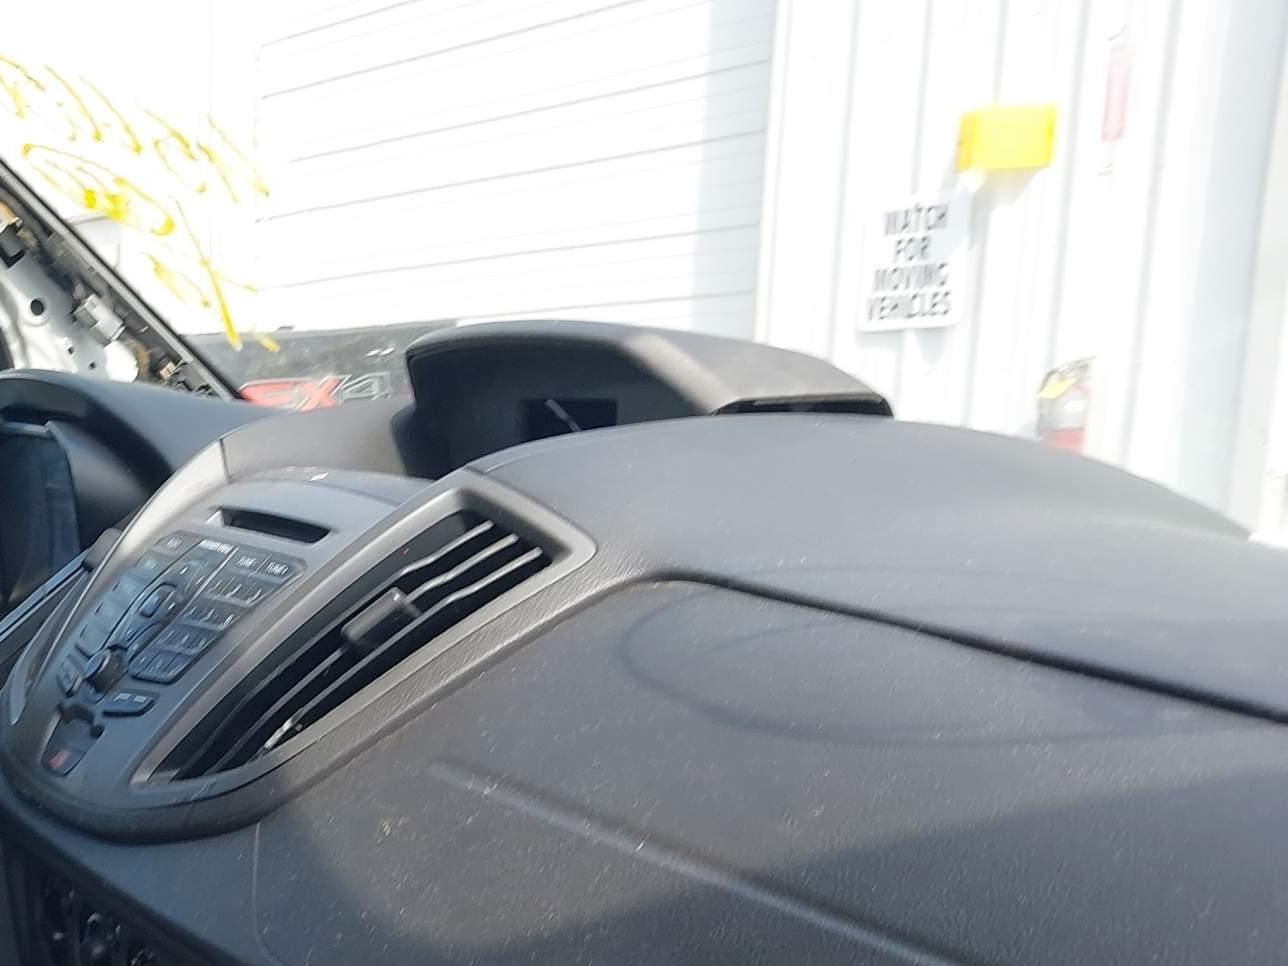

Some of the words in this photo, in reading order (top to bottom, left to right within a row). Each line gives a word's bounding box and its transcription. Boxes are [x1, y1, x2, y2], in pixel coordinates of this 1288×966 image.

[883, 204, 949, 236] WATCH
[893, 235, 931, 262] FOR
[873, 262, 948, 292] MOVING
[867, 290, 952, 321] VEHICLES
